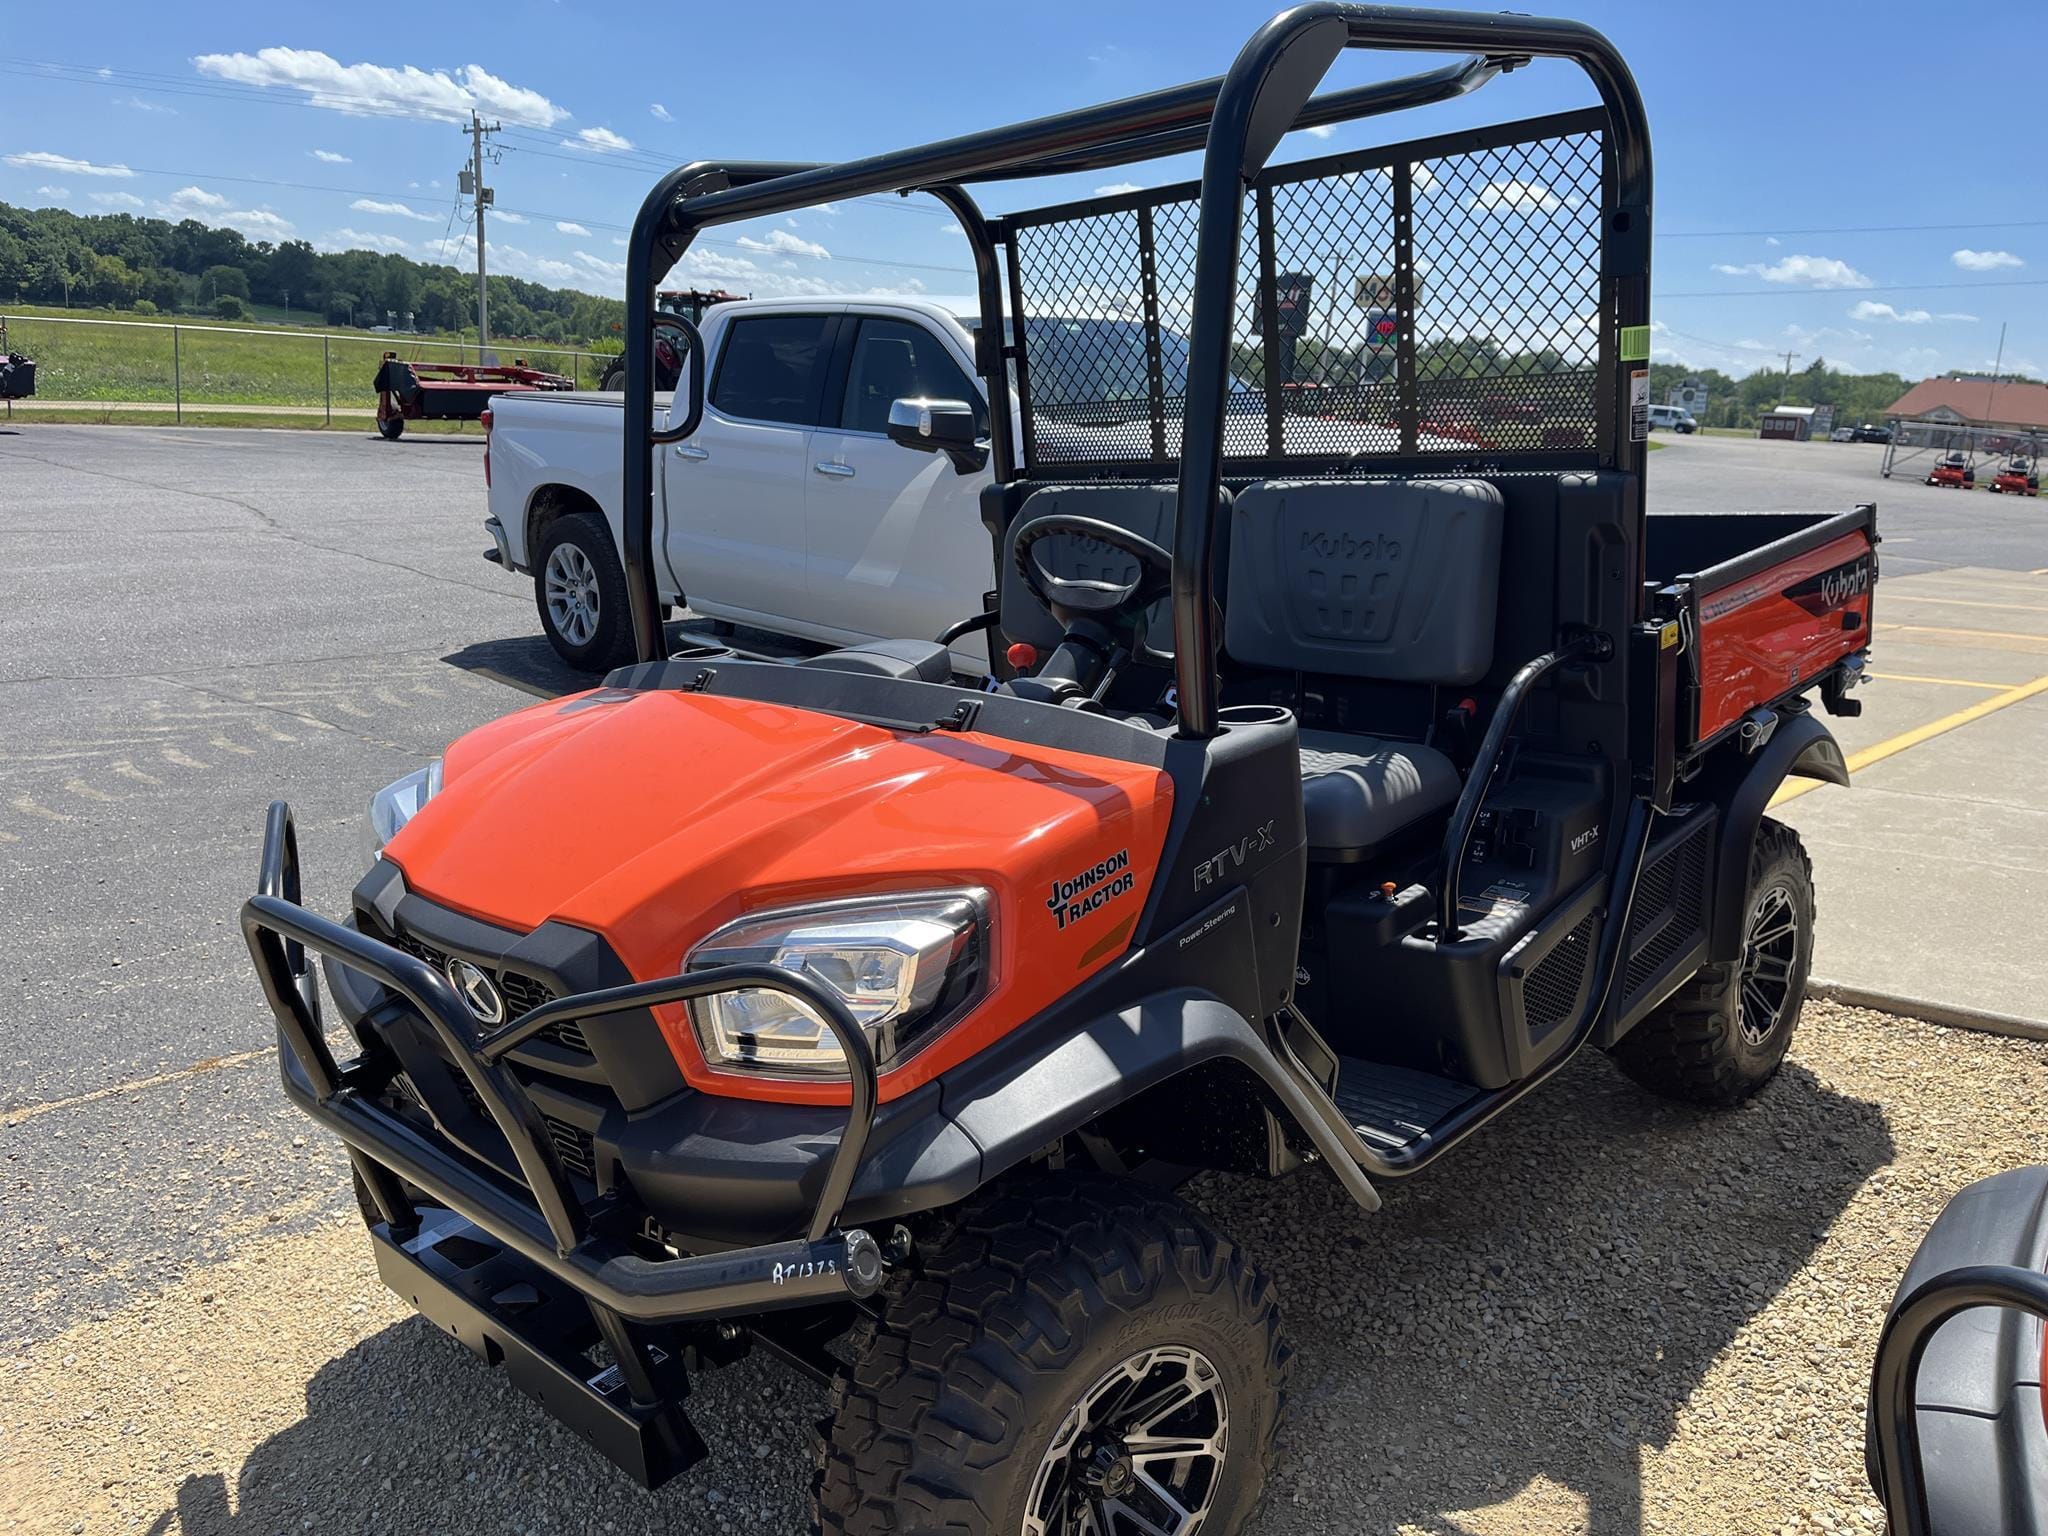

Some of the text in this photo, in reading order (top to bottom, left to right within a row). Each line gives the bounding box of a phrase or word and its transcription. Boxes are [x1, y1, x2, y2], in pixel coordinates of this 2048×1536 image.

[1300, 531, 1401, 560] Kubota
[1821, 563, 1868, 607] Kubota
[1193, 819, 1275, 893] RTV-X
[1571, 825, 1599, 851] VHT-X
[1047, 848, 1129, 909] JOHNSON
[1052, 872, 1134, 931] TRACTOR
[1179, 905, 1236, 948] Power Steering
